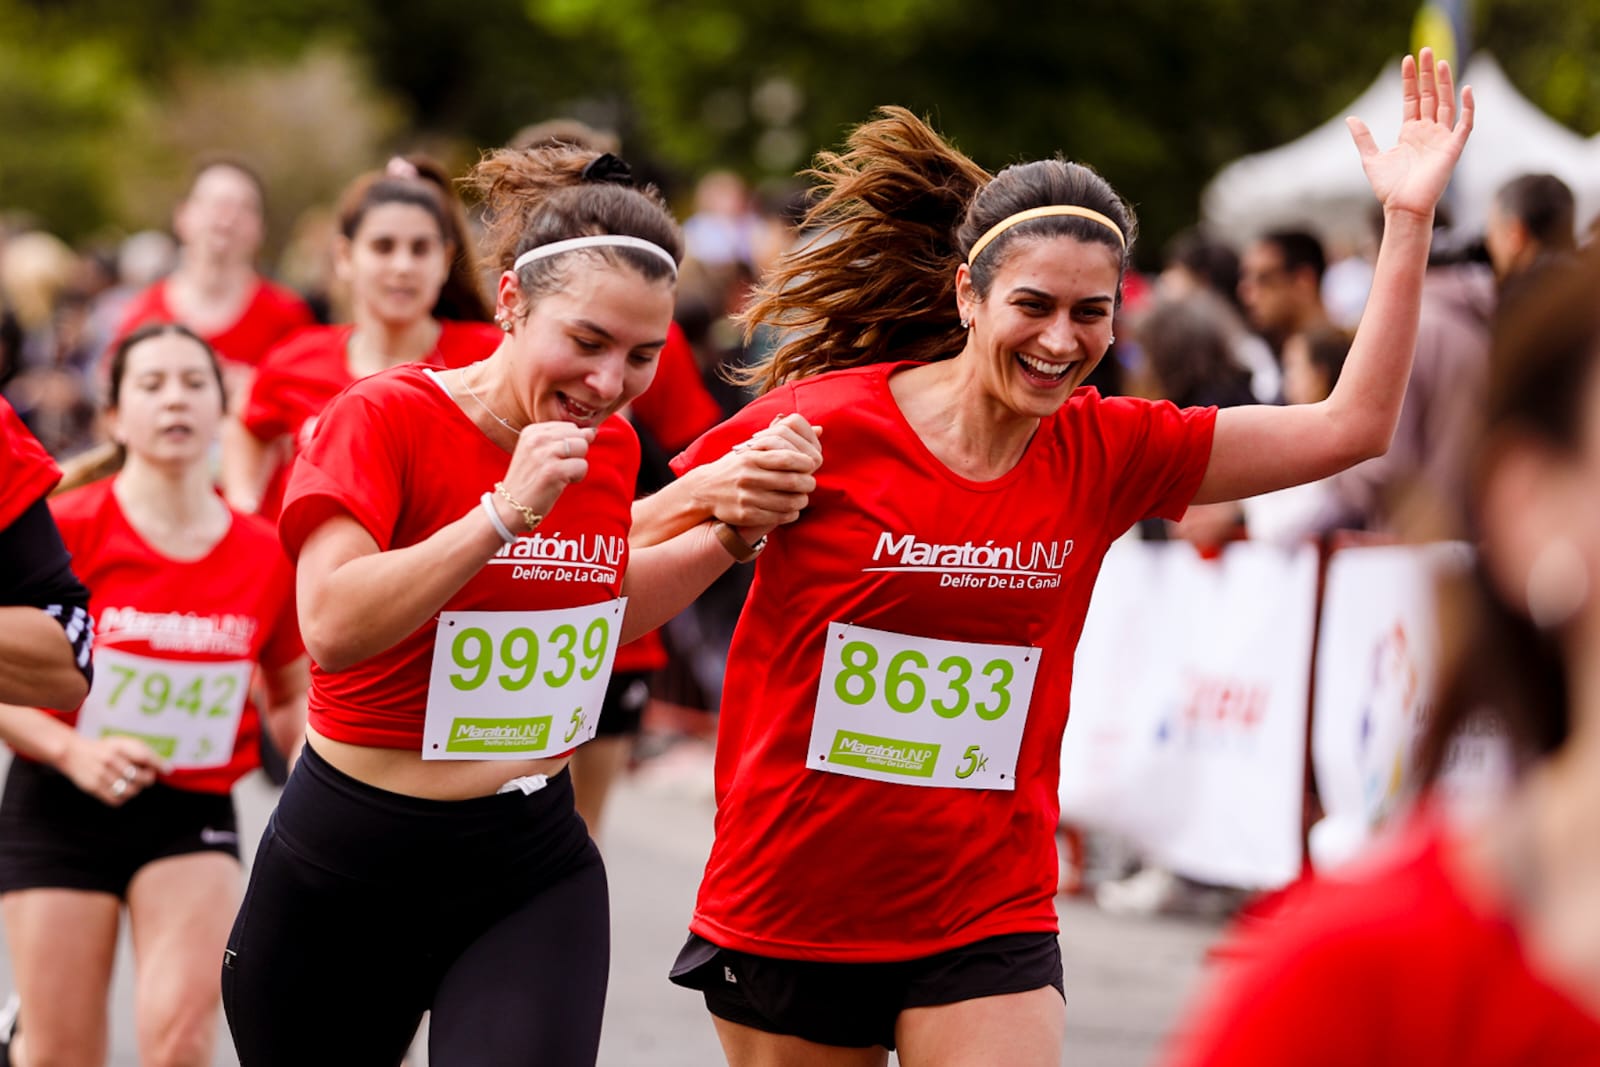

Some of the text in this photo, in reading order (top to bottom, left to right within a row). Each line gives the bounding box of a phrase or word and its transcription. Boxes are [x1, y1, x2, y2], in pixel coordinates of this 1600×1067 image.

[512, 566, 617, 585] Delfor De La Canal
[940, 573, 1062, 590] Delfor De La Canal
[449, 617, 610, 692] 9939
[834, 640, 1015, 721] 8633
[107, 663, 238, 718] 7942
